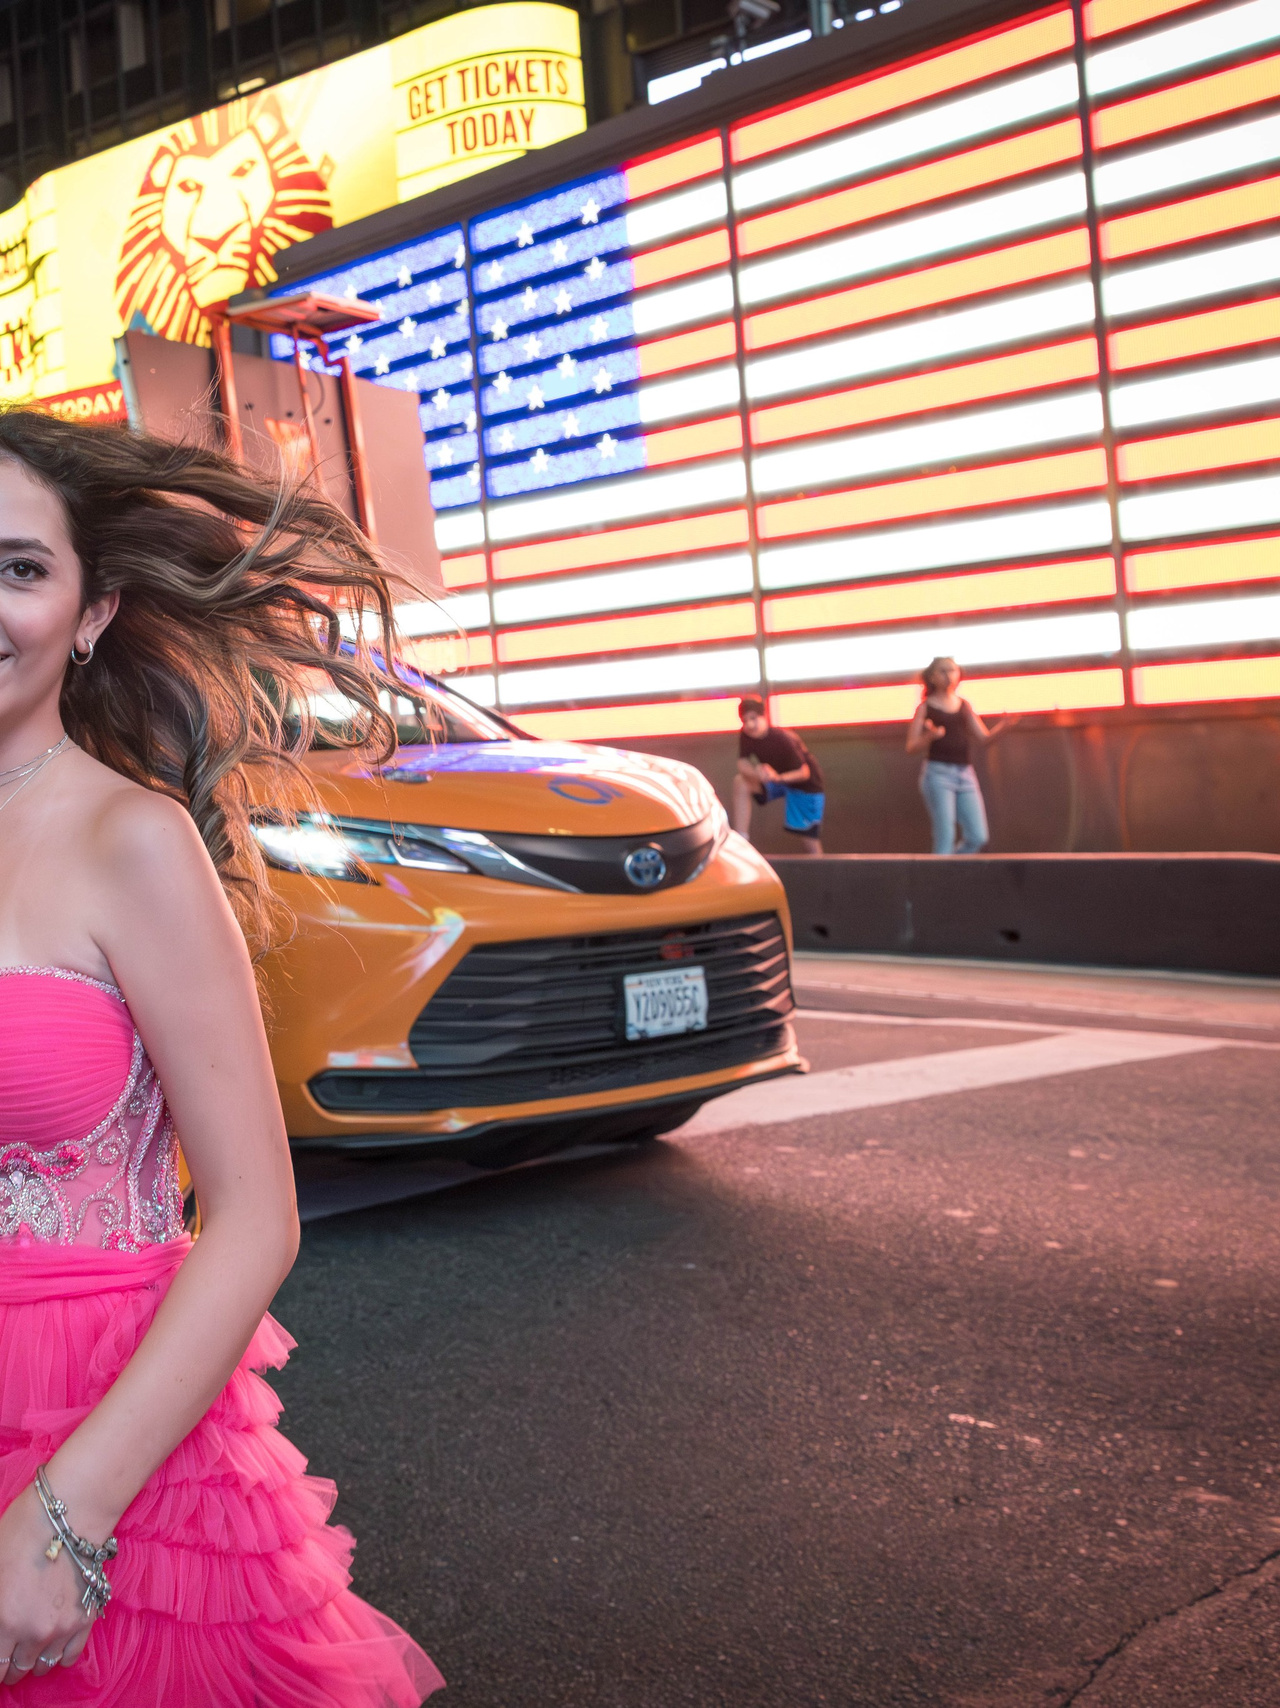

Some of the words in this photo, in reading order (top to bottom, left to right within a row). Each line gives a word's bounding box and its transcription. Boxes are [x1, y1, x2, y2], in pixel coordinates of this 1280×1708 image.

[408, 74, 448, 121] GET
[456, 59, 568, 103] TICKETS
[446, 107, 535, 155] TODAY
[48, 389, 124, 417] TODAY
